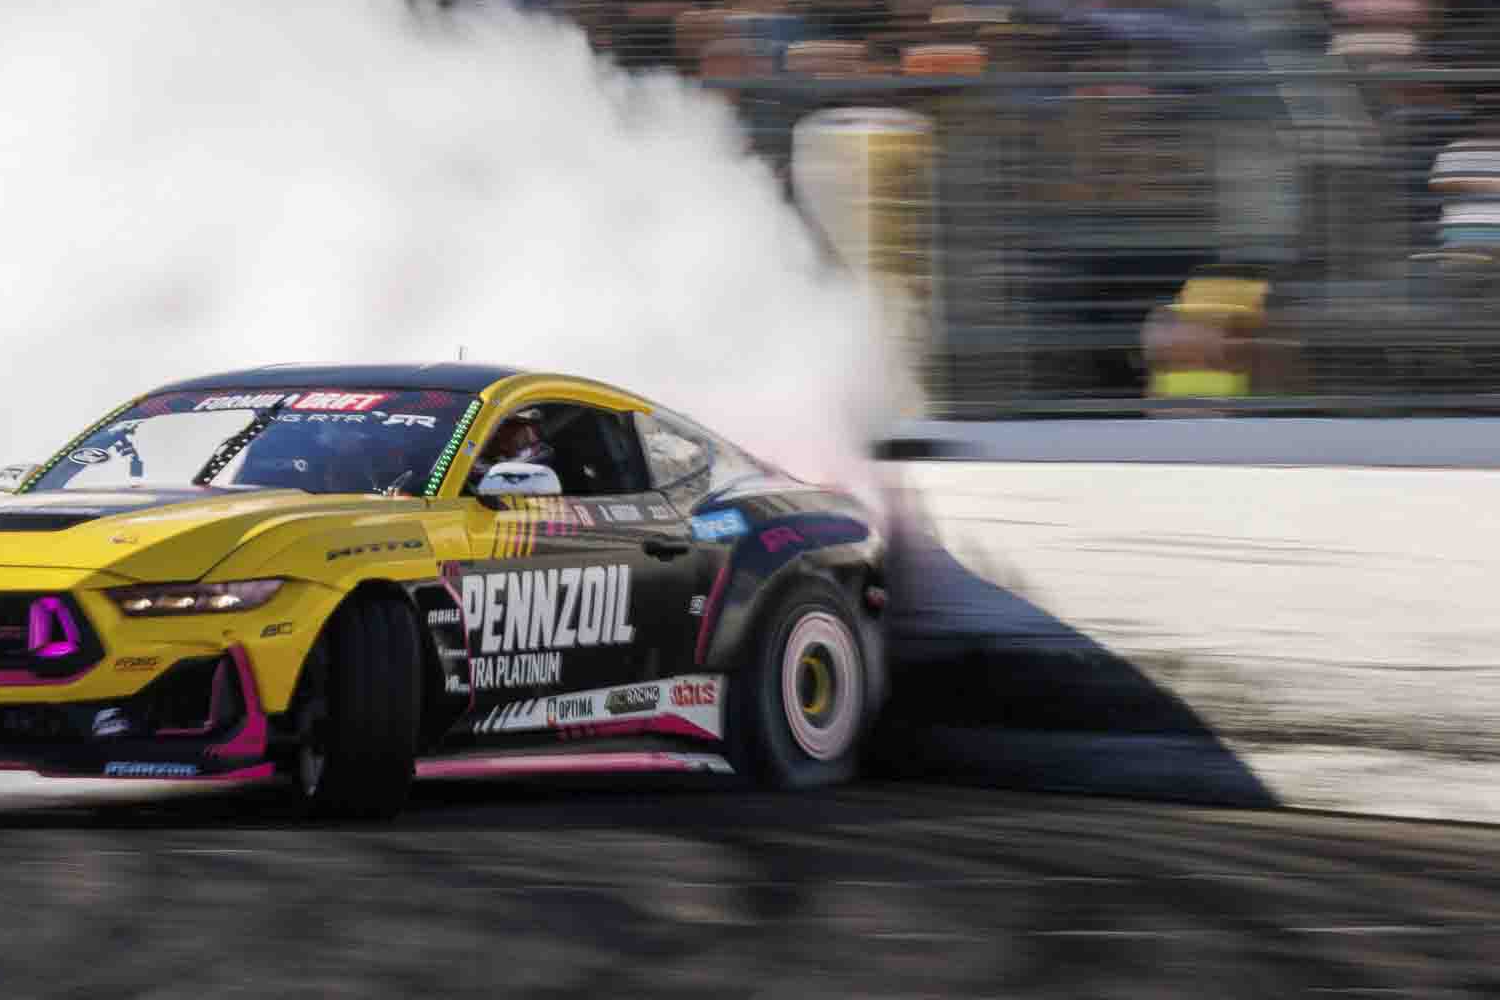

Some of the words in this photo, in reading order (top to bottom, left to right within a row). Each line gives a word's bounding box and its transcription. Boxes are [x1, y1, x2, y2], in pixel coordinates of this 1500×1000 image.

[294, 392, 384, 410] DRIFT
[462, 564, 635, 653] PENNZOIL
[496, 651, 562, 686] PLATINUM
[559, 697, 593, 720] OPTIMA
